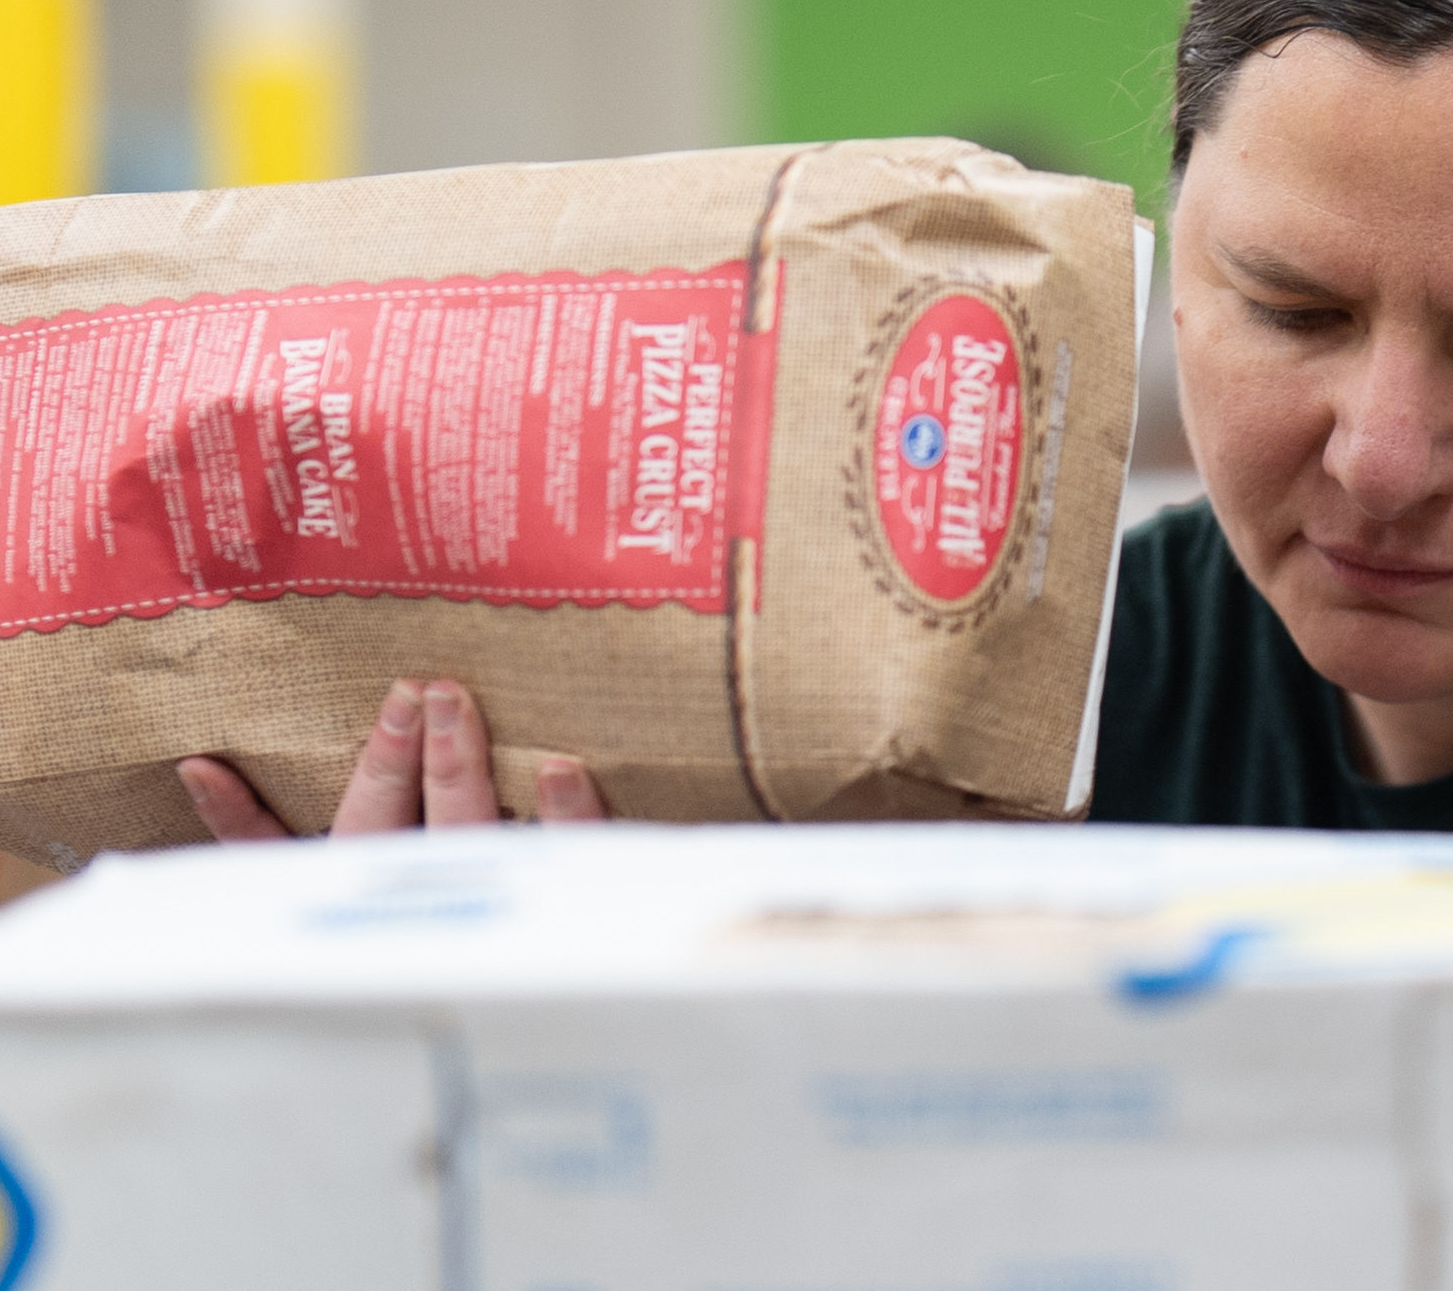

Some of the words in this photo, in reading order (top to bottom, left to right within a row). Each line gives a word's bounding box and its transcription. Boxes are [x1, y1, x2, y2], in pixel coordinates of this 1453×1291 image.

[279, 339, 328, 454] BANANA
[630, 322, 686, 429] PIZZA
[941, 335, 1008, 492] PURPOSE
[319, 392, 359, 482] BRAN
[679, 363, 724, 514] PERFECT
[296, 459, 340, 539] CAKE
[617, 434, 678, 556] CRUST
[936, 500, 987, 568] ALL
